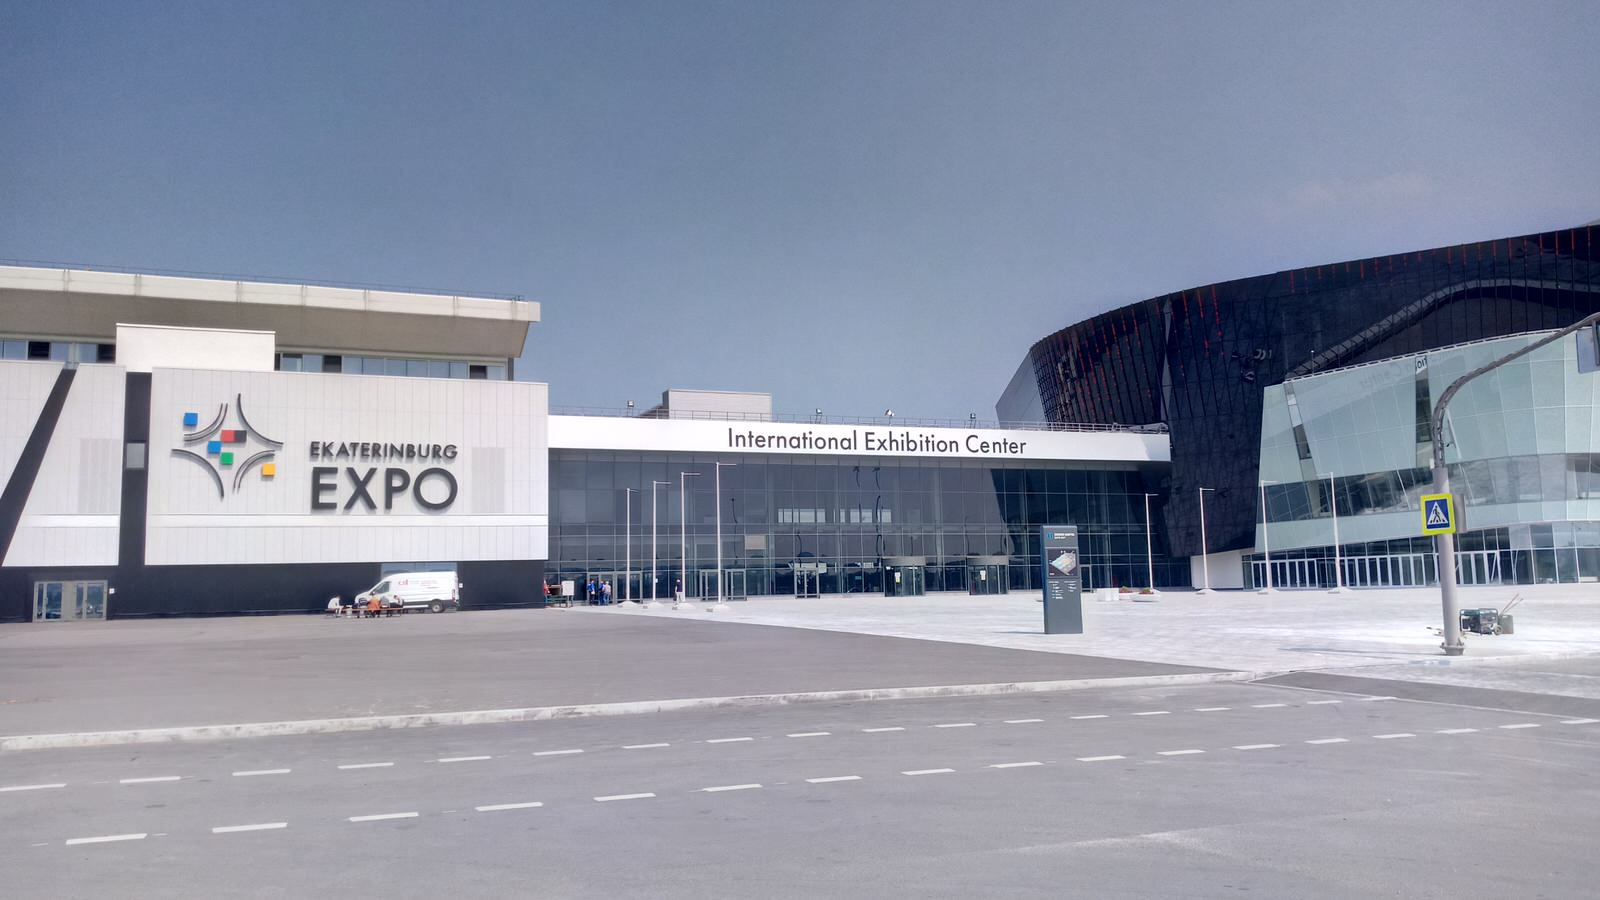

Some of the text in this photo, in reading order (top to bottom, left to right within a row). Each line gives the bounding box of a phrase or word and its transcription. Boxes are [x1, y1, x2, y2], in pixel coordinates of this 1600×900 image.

[310, 441, 458, 460] EKATERINBURG
[729, 427, 1027, 455] International Exhibition Center
[312, 466, 459, 511] EXPO
